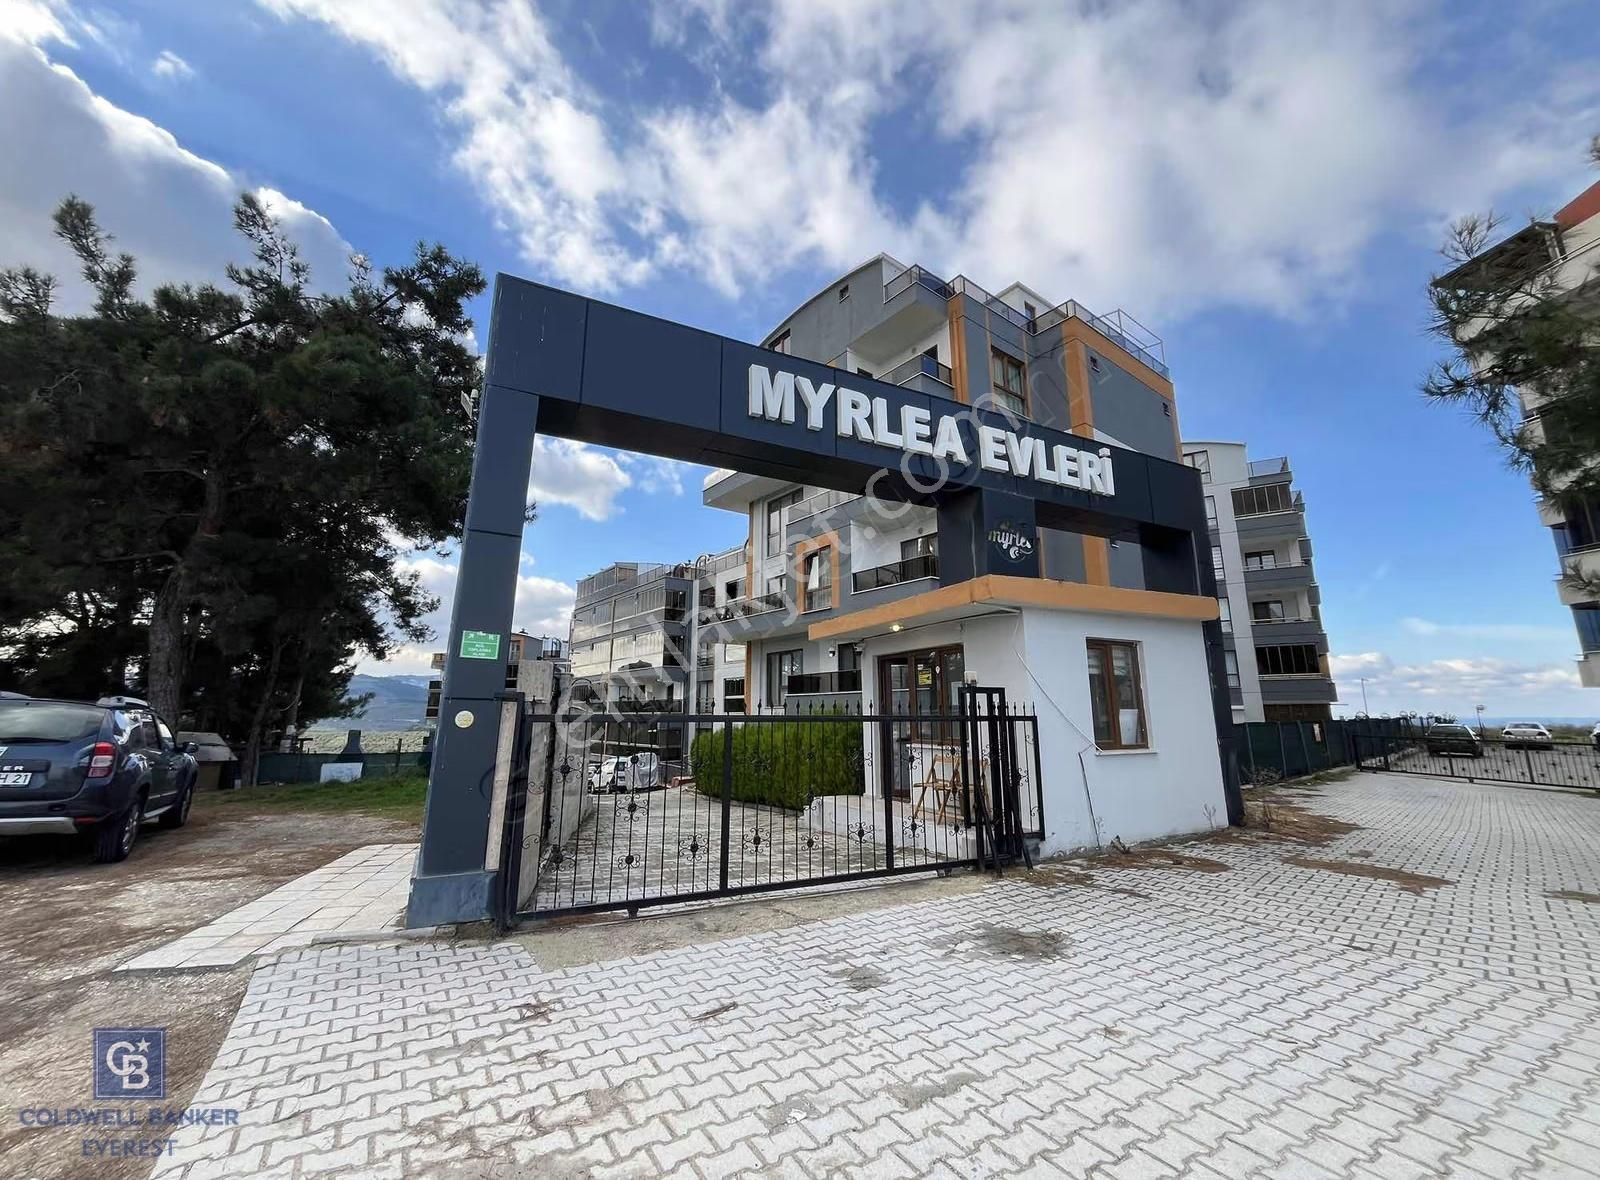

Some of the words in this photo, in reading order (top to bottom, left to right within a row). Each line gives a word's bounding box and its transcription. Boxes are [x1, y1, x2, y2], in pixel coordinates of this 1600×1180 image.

[748, 363, 967, 464] MYRLEA
[978, 425, 1115, 497] EVLERİ
[13, 774, 27, 783] 21
